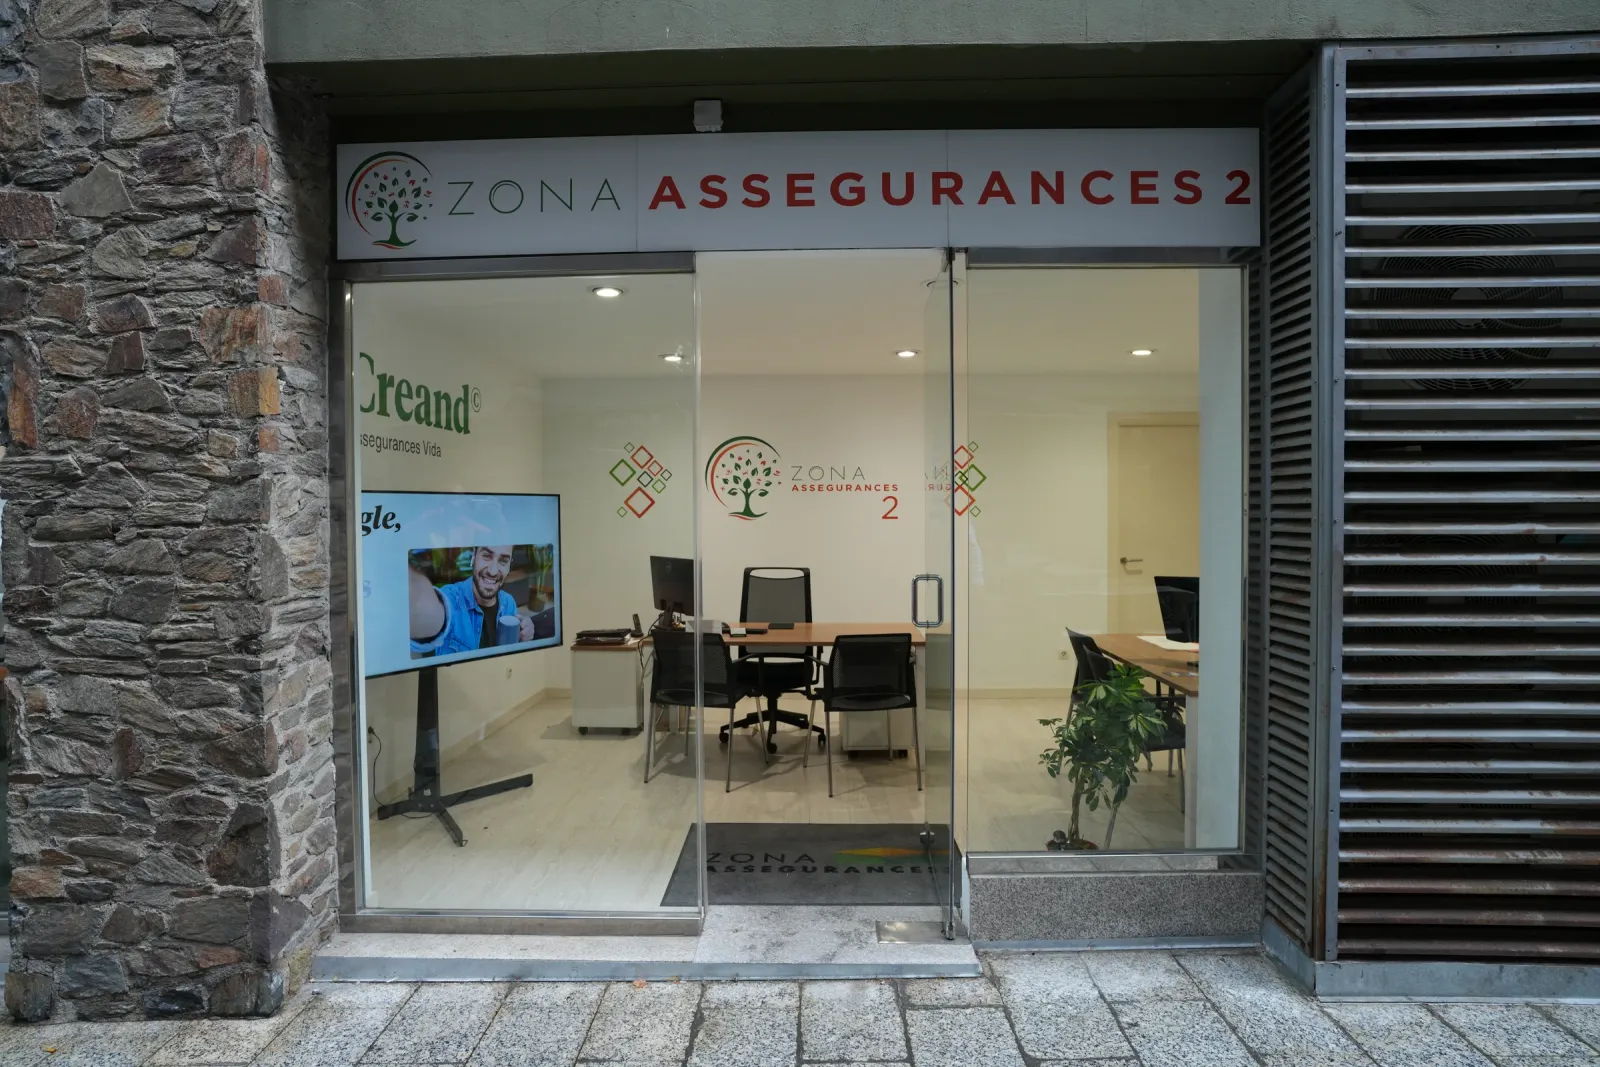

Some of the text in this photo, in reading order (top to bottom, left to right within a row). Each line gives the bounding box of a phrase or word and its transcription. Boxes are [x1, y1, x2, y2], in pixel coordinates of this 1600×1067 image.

[447, 169, 1251, 215] ZONA ASSEGURANCES 2
[423, 440, 441, 457] Vida
[791, 465, 866, 481] ZONA
[791, 484, 899, 492] ASSEGURANCES
[881, 495, 899, 520] 2
[706, 853, 815, 863] ZONA
